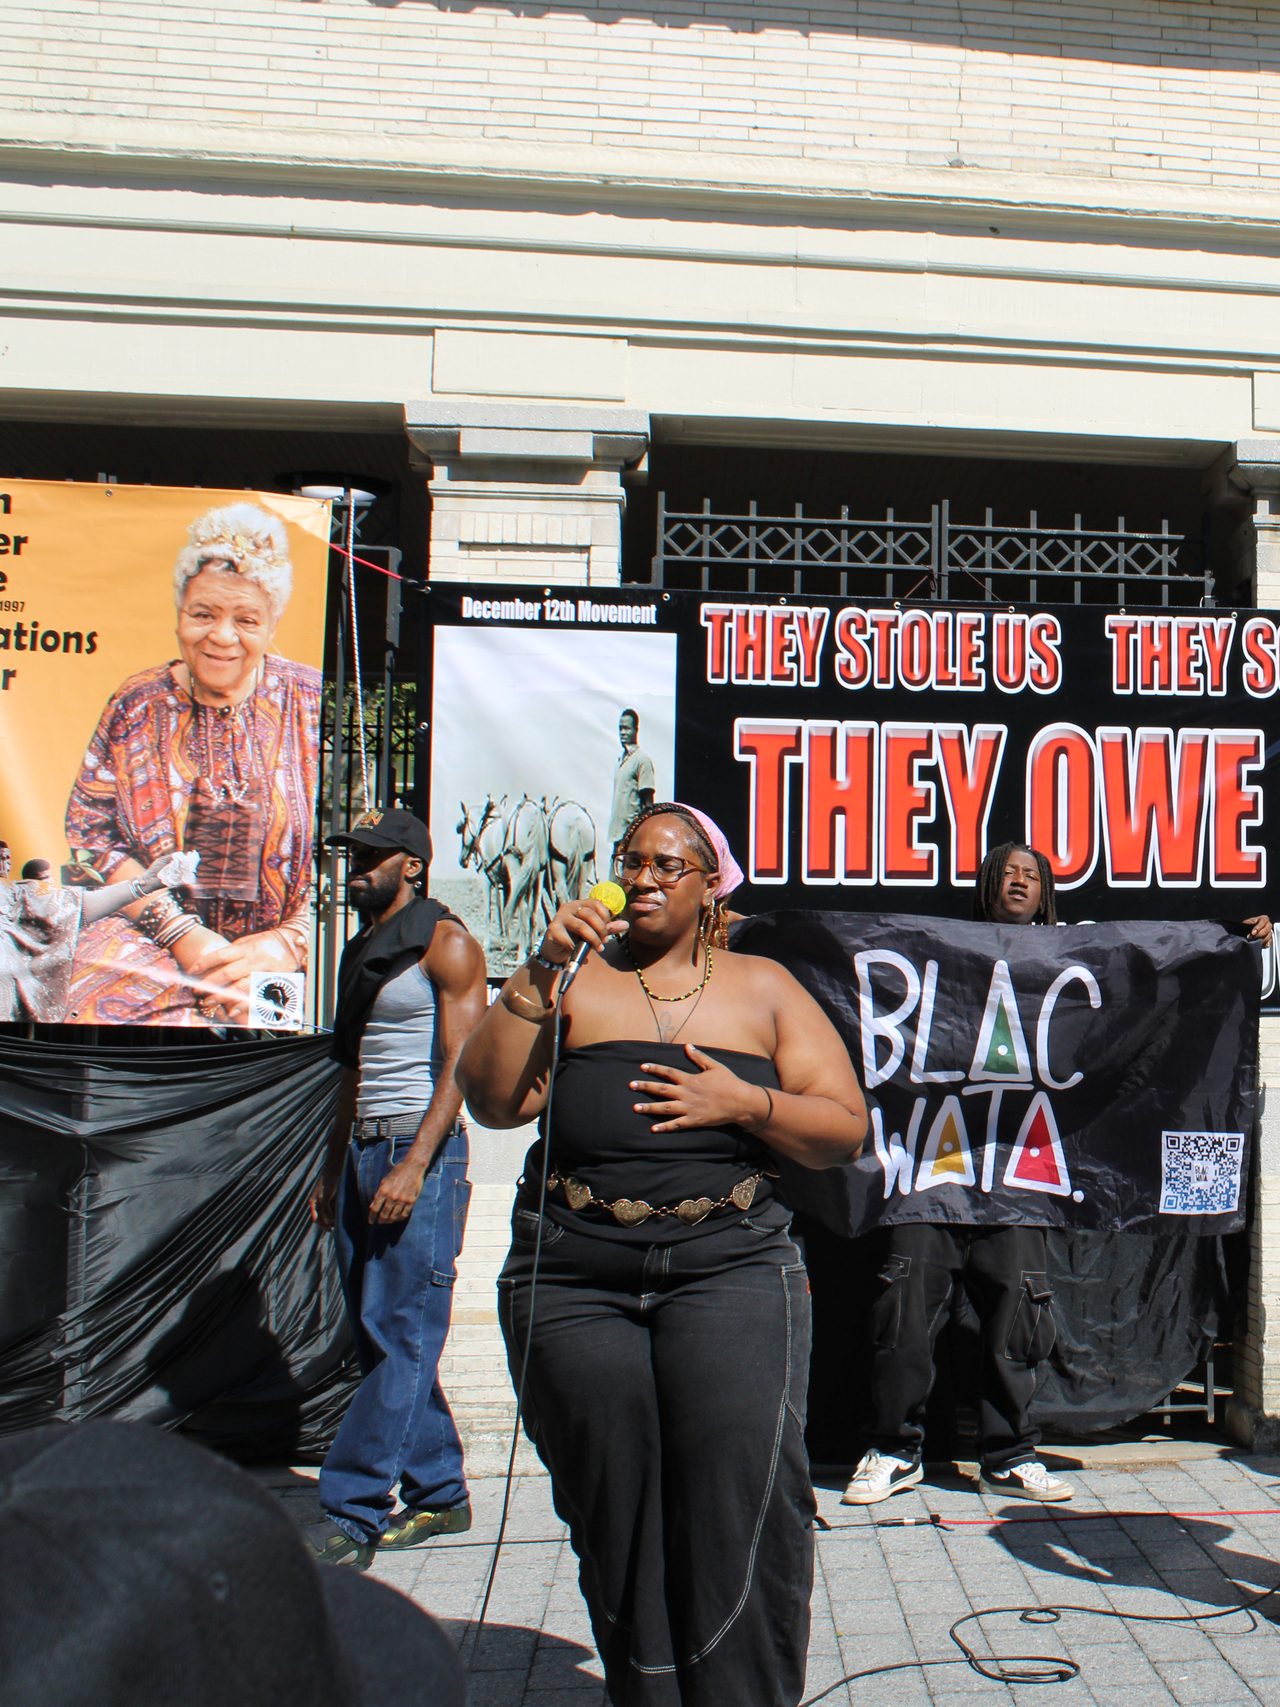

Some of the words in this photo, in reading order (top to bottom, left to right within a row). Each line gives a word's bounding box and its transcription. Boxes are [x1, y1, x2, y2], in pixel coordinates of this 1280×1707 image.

[461, 596, 541, 620] December
[543, 599, 575, 622] 12th
[577, 600, 657, 625] Movement
[701, 603, 829, 687] THEY
[835, 607, 986, 691] STOLE
[993, 611, 1062, 694] US
[1105, 614, 1236, 696] THEY
[733, 717, 1008, 887] THEY
[1025, 722, 1267, 891] OWE
[854, 949, 1102, 1089] BLAC
